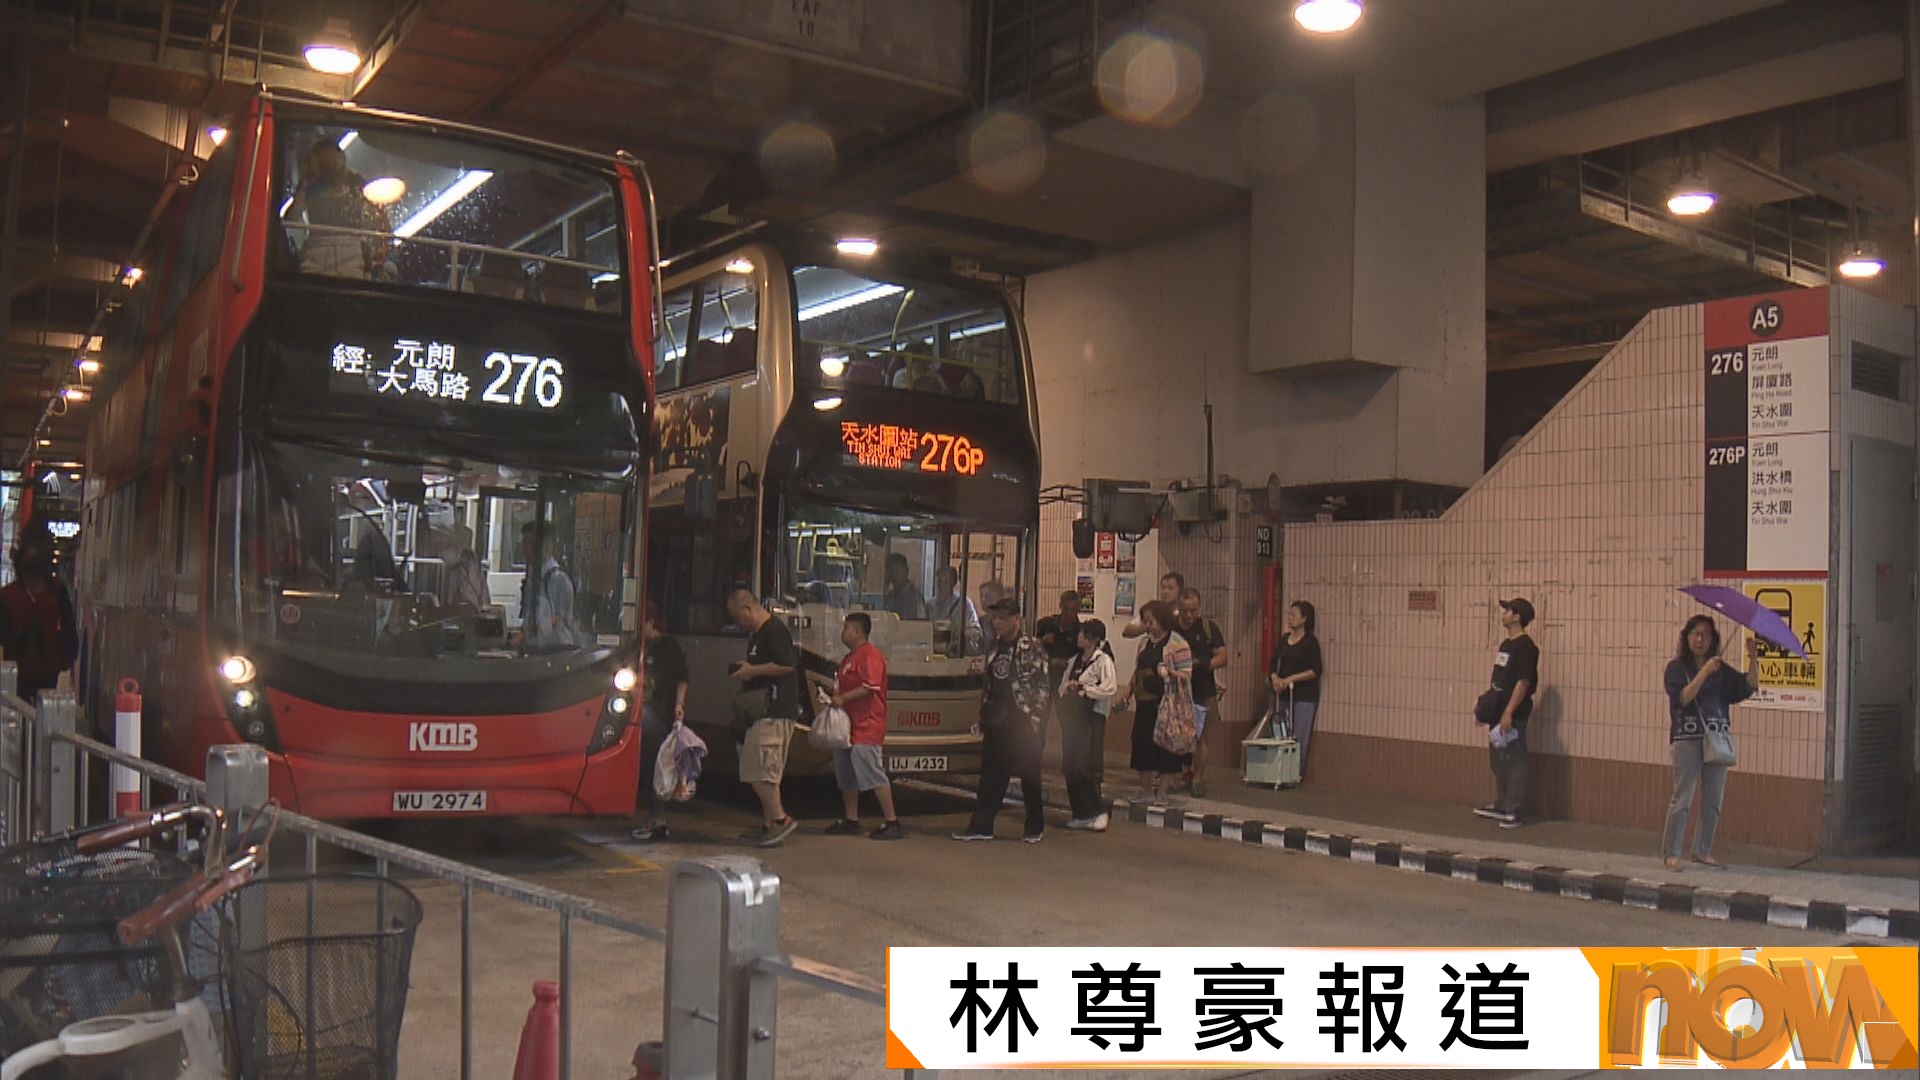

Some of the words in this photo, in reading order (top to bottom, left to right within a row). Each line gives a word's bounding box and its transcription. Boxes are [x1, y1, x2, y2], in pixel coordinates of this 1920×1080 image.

[1752, 306, 1779, 330] A5
[392, 339, 456, 371] 元朗
[1752, 345, 1778, 361] 元朗
[1711, 352, 1744, 376] 276
[376, 364, 472, 401] 大馬路
[482, 351, 563, 408] 276
[1752, 402, 1792, 419] 天水圍
[920, 432, 984, 476] 276P
[1709, 446, 1746, 466] 276P
[1752, 442, 1778, 457] 元朗
[1752, 470, 1792, 486] 洪水橋
[1752, 500, 1792, 515] 天水圍
[910, 711, 942, 727] KMB
[409, 722, 478, 752] KMB
[892, 759, 909, 769] UJ
[914, 759, 945, 769] 4232
[398, 794, 423, 809] WU
[432, 793, 483, 809] 2974
